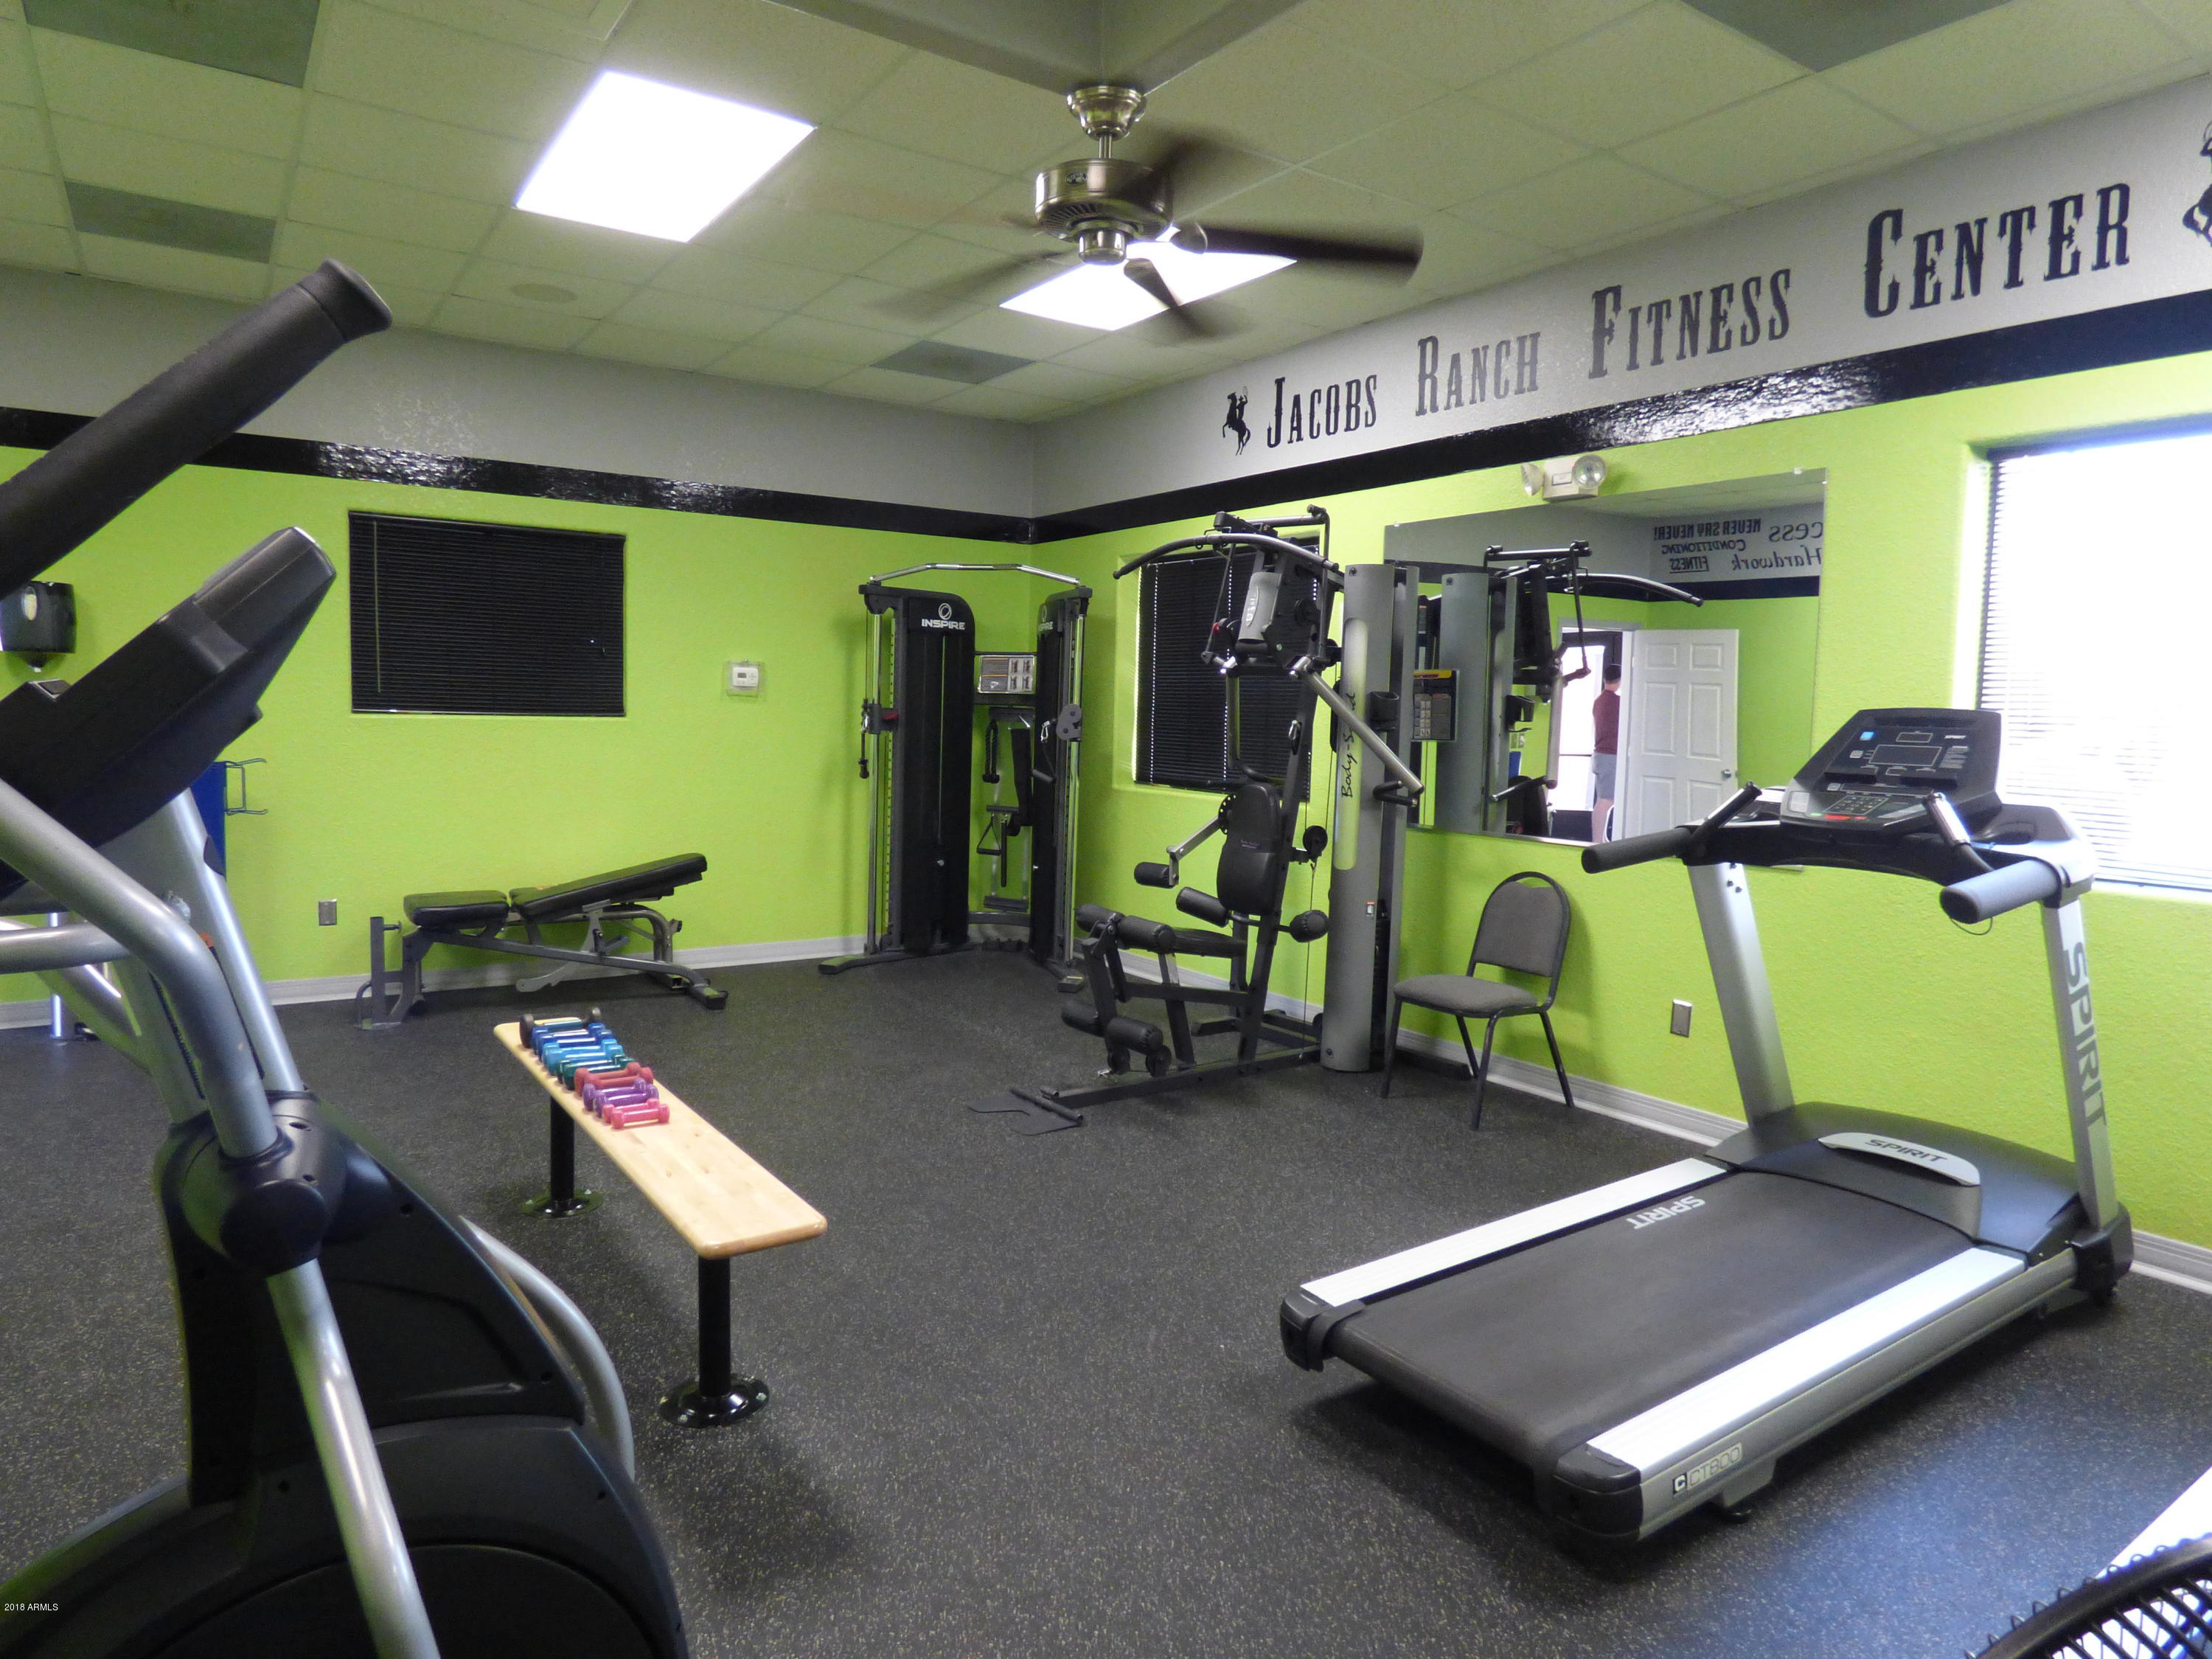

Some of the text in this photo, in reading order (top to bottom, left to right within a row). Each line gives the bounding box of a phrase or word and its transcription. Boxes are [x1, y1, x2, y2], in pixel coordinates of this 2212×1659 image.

[1267, 183, 2130, 448] JACOBS RANCH FITNESS CENTER
[921, 618, 965, 630] INSPIRE
[2064, 942, 2107, 1127] SPIRIT
[1865, 1139, 1947, 1162] SPIRIT
[1626, 1195, 1706, 1230] SPIRIT
